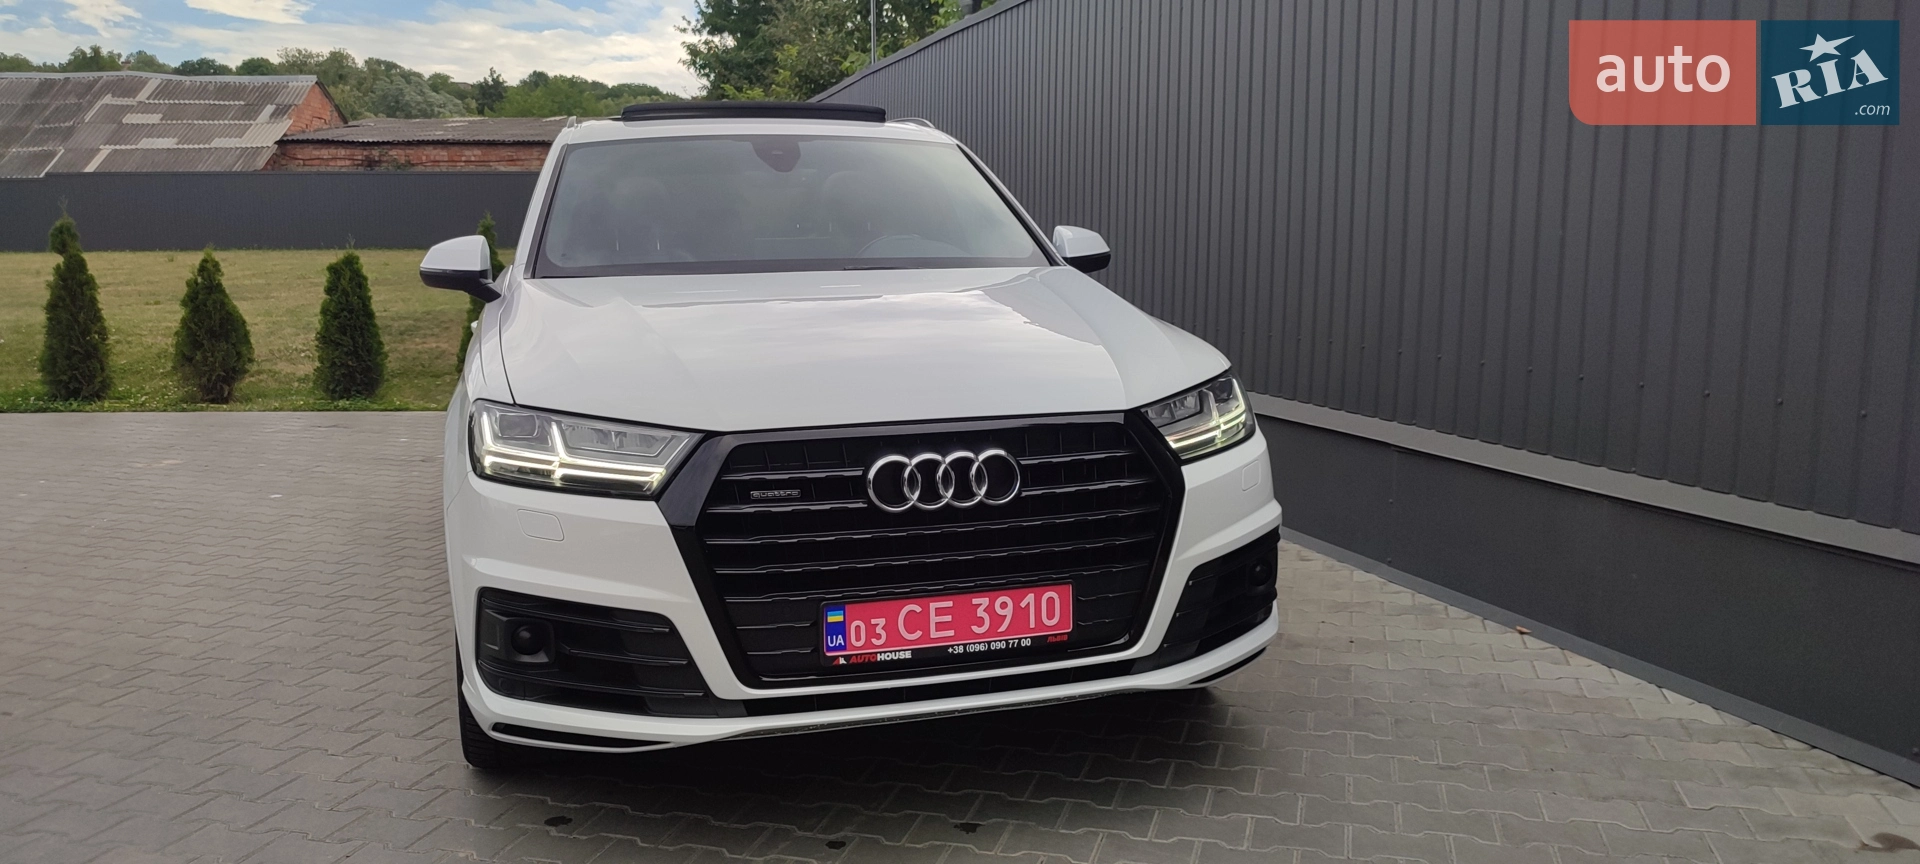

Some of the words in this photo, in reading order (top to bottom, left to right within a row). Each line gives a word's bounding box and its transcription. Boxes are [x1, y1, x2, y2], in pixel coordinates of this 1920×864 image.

[849, 617, 888, 647] 03
[897, 600, 956, 641] CE
[970, 591, 1061, 635] 3910
[827, 634, 845, 647] UA
[947, 645, 964, 654] +38
[966, 642, 988, 652] (096)
[990, 640, 1006, 650] 090
[1008, 639, 1019, 648] 77
[1020, 637, 1032, 647] 00
